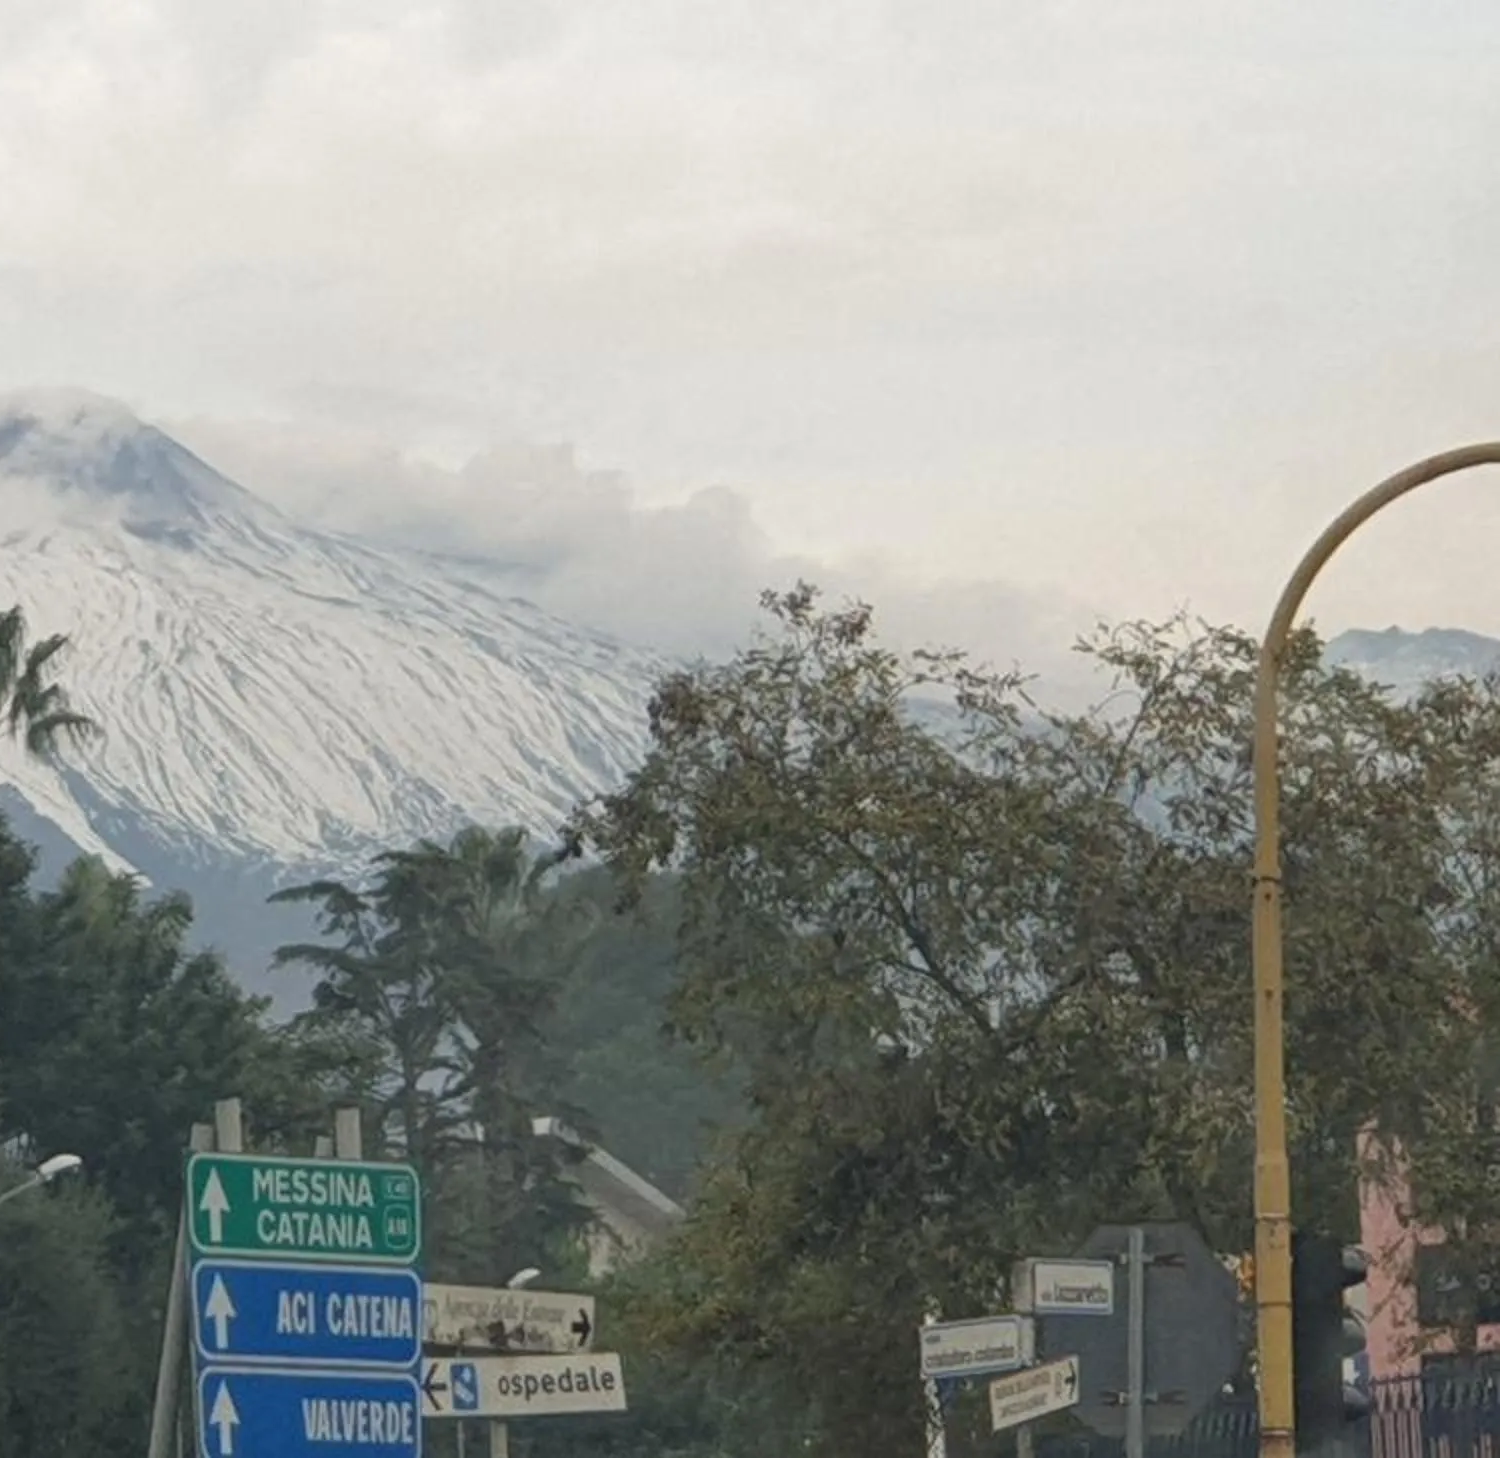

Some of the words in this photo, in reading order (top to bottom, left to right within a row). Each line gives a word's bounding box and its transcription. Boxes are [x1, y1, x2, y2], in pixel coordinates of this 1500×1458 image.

[252, 1168, 375, 1208] MESSINA
[256, 1209, 374, 1249] CATANIA
[276, 1290, 316, 1335] ACI
[326, 1292, 413, 1339] CATENA
[498, 1365, 615, 1402] ospedale
[301, 1397, 414, 1444] VALVERDE
